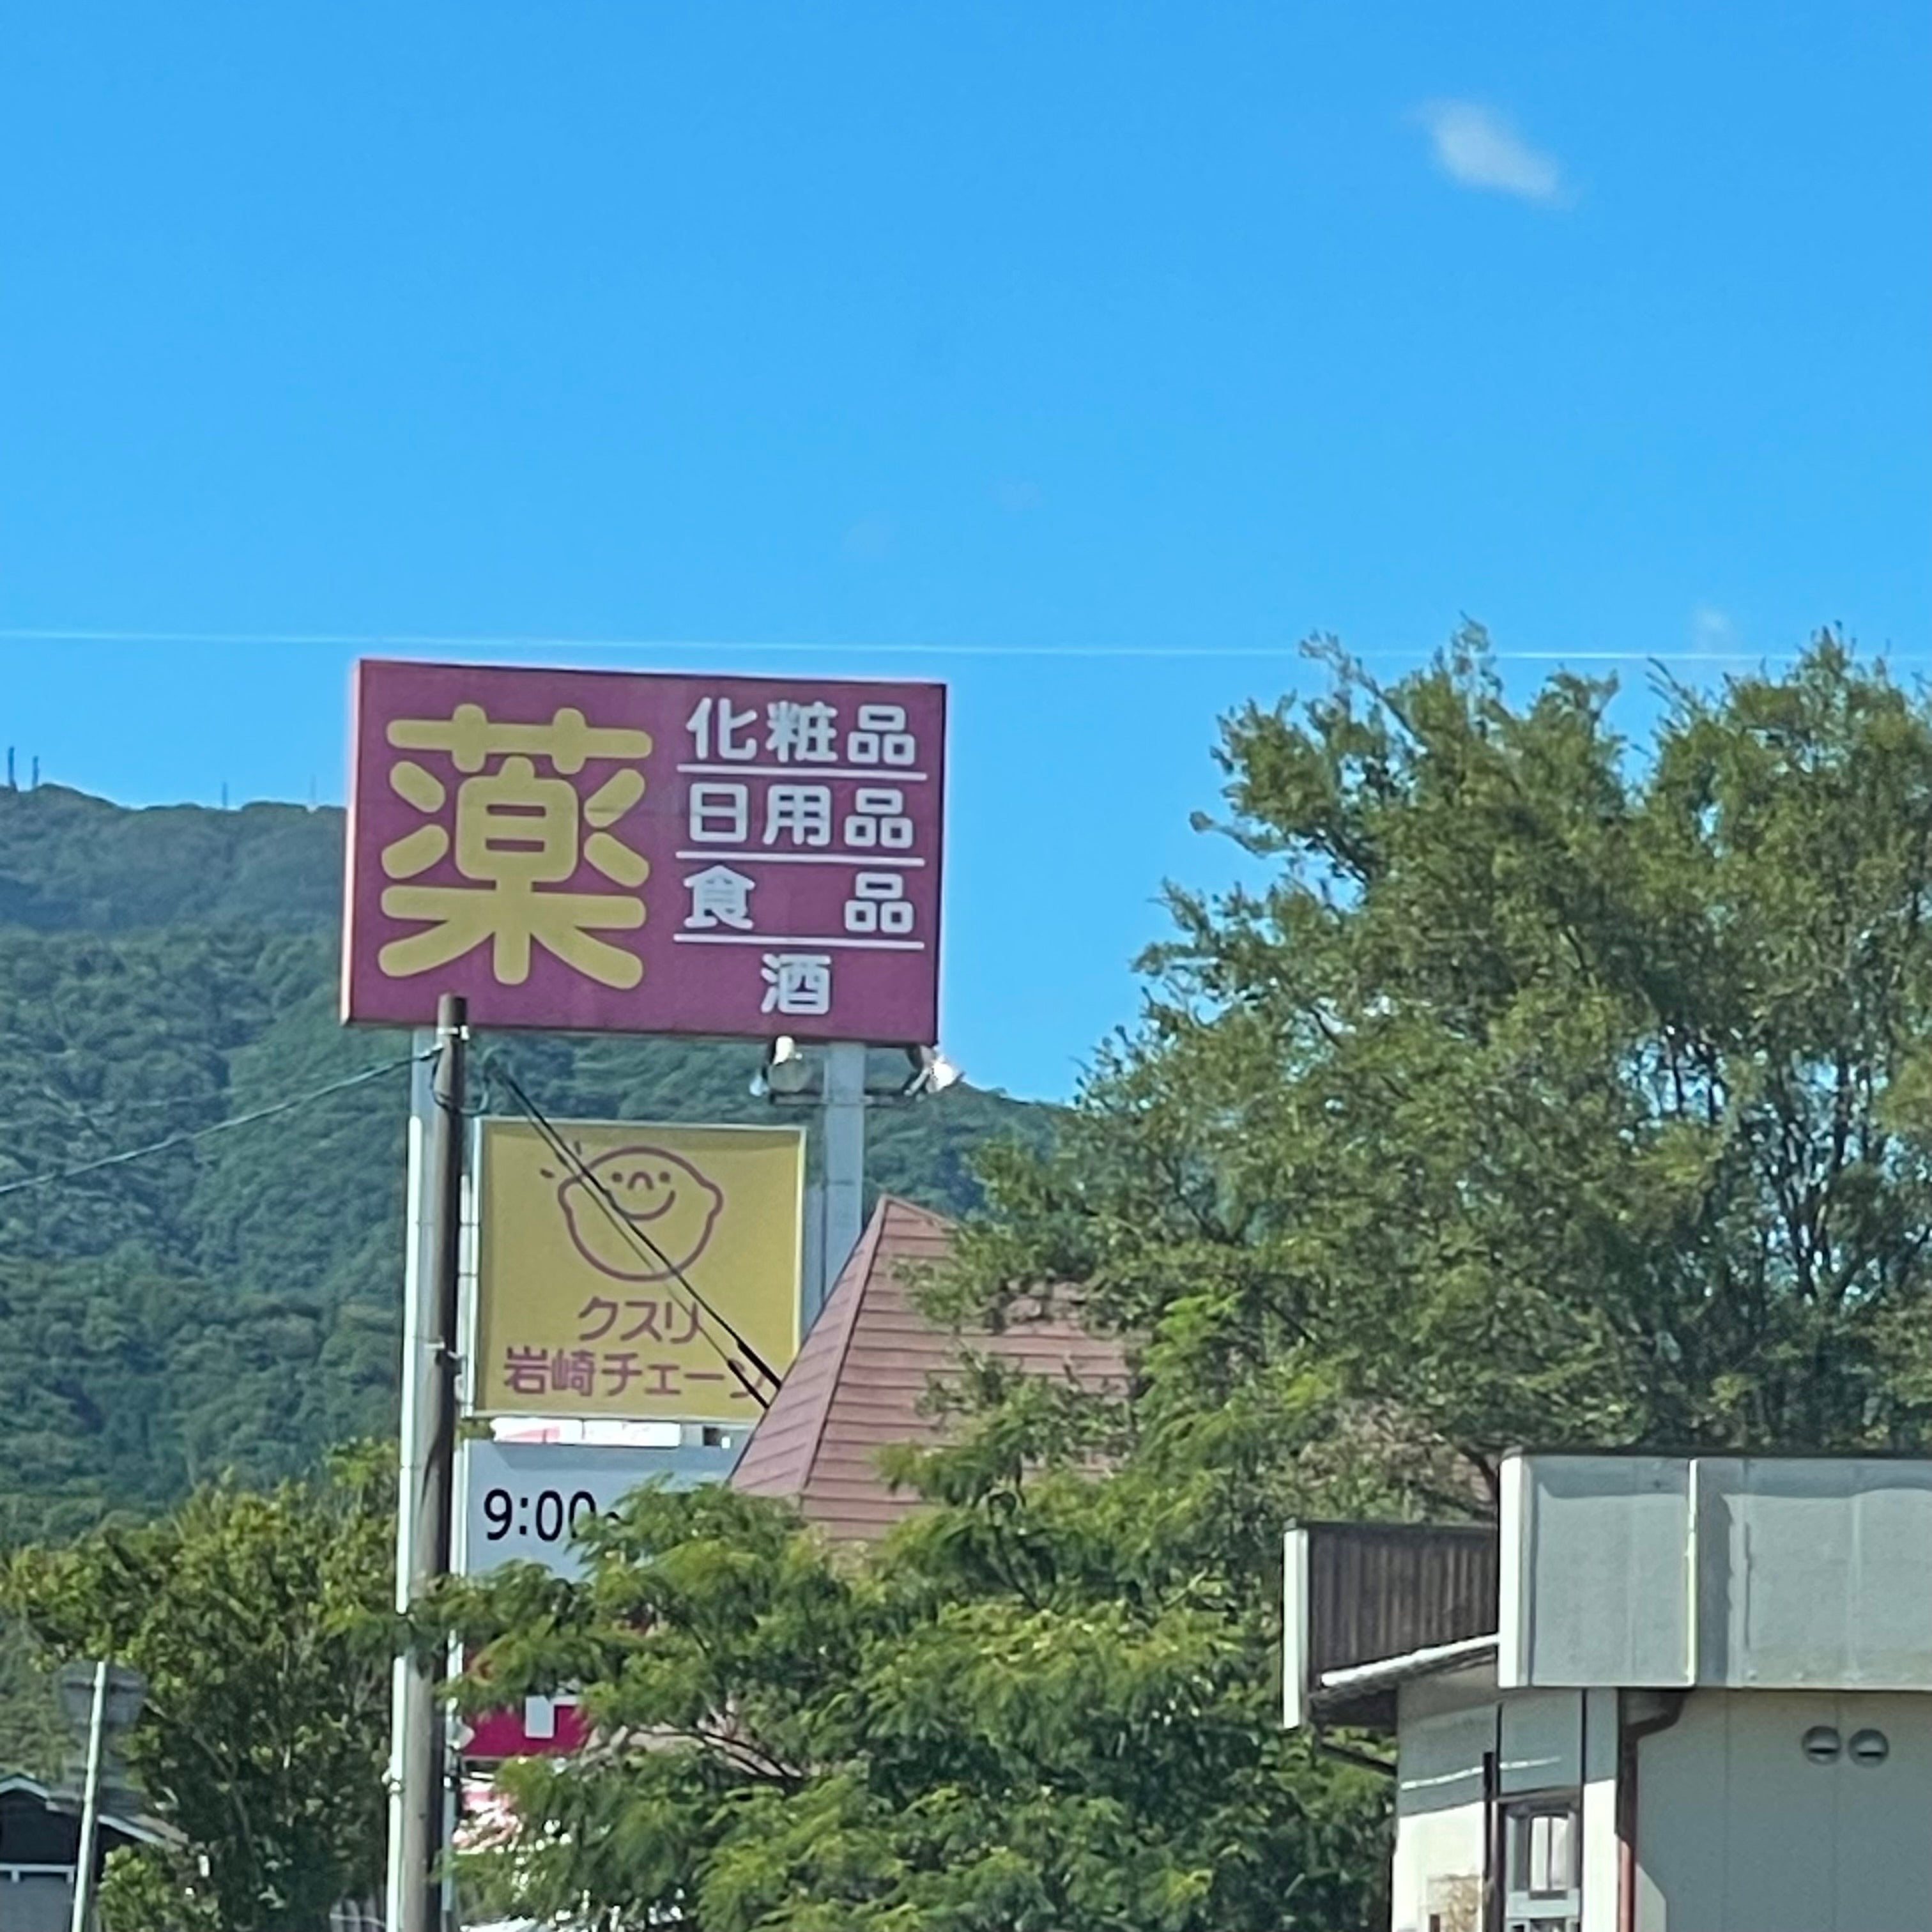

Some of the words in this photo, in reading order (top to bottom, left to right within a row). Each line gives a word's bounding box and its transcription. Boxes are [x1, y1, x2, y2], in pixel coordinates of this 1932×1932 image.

[686, 696, 916, 765] 化粧品
[378, 703, 653, 990] 薬
[689, 782, 914, 848] 日用品
[760, 953, 831, 1016] 酒
[578, 1296, 700, 1342] クスリ
